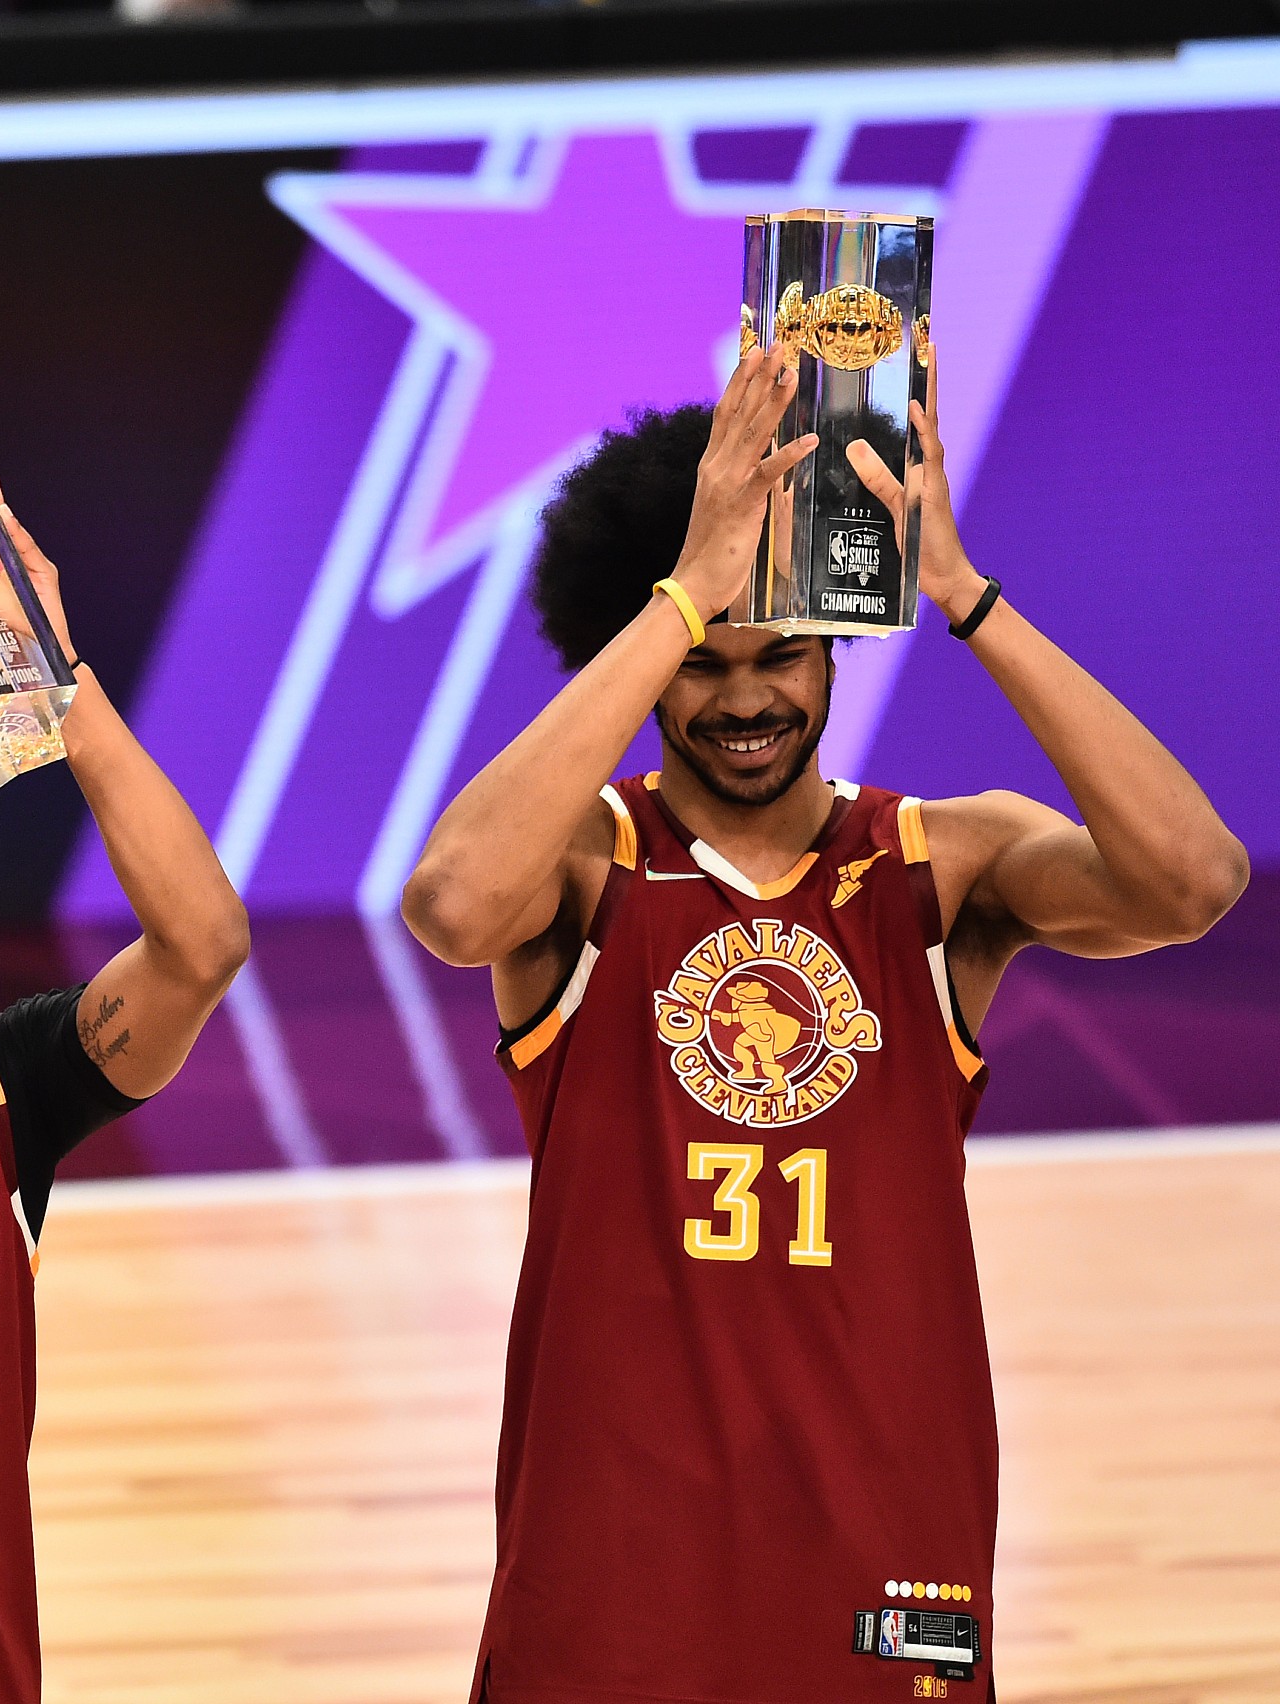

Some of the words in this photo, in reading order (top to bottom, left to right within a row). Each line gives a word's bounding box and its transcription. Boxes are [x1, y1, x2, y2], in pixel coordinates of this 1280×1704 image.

[843, 507, 872, 518] 2022
[848, 546, 880, 566] SKILLS
[847, 563, 880, 576] CHALLENGE
[821, 592, 886, 615] CHAMPIONS
[654, 918, 882, 1052] CAVALIERS
[670, 1044, 858, 1129] CLEVELAND
[684, 1142, 833, 1267] 31
[908, 1623, 919, 1633] 54
